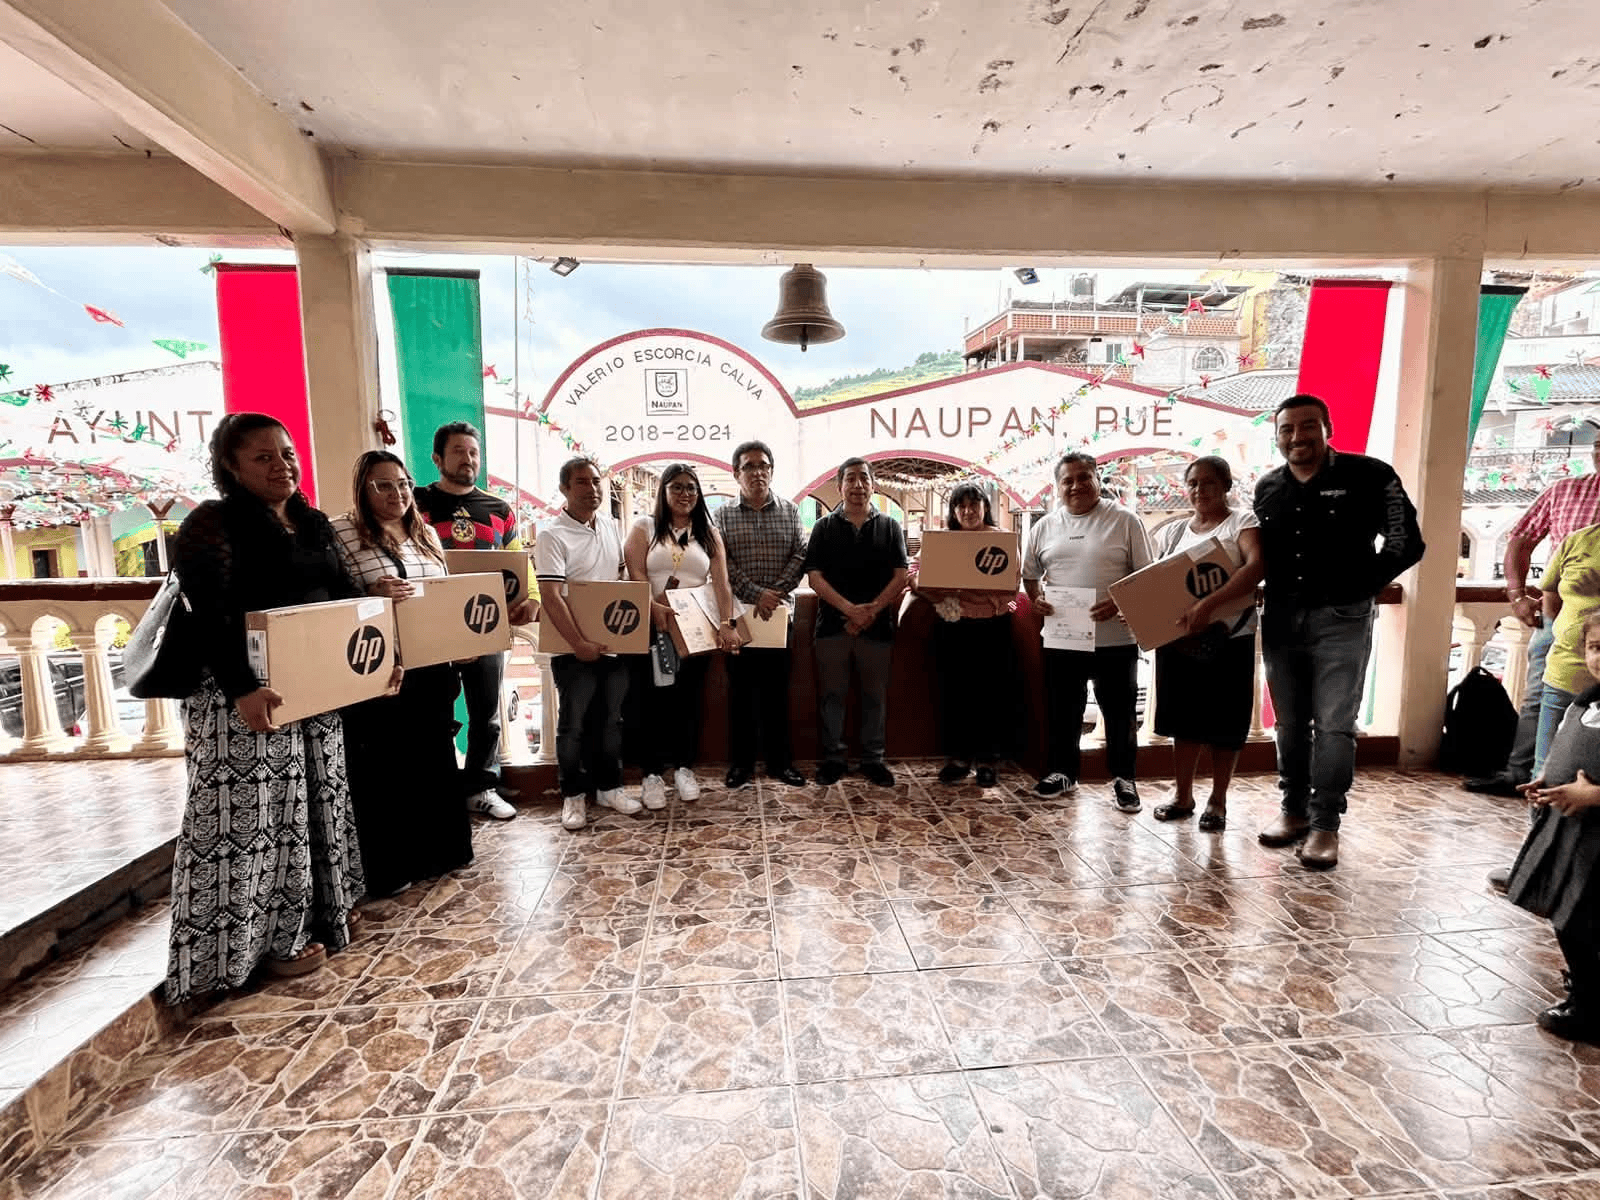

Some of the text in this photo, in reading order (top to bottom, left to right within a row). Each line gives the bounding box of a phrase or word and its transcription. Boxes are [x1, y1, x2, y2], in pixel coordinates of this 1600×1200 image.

[565, 356, 625, 406] VALERIO
[634, 347, 711, 367] ESCORCIA
[720, 362, 763, 401] CALVA
[1095, 405, 1183, 437] PUE.
[978, 545, 1007, 576] hp
[1192, 566, 1223, 597] hp
[468, 592, 497, 635] hp
[607, 599, 638, 636] hp
[350, 624, 383, 676] hp
